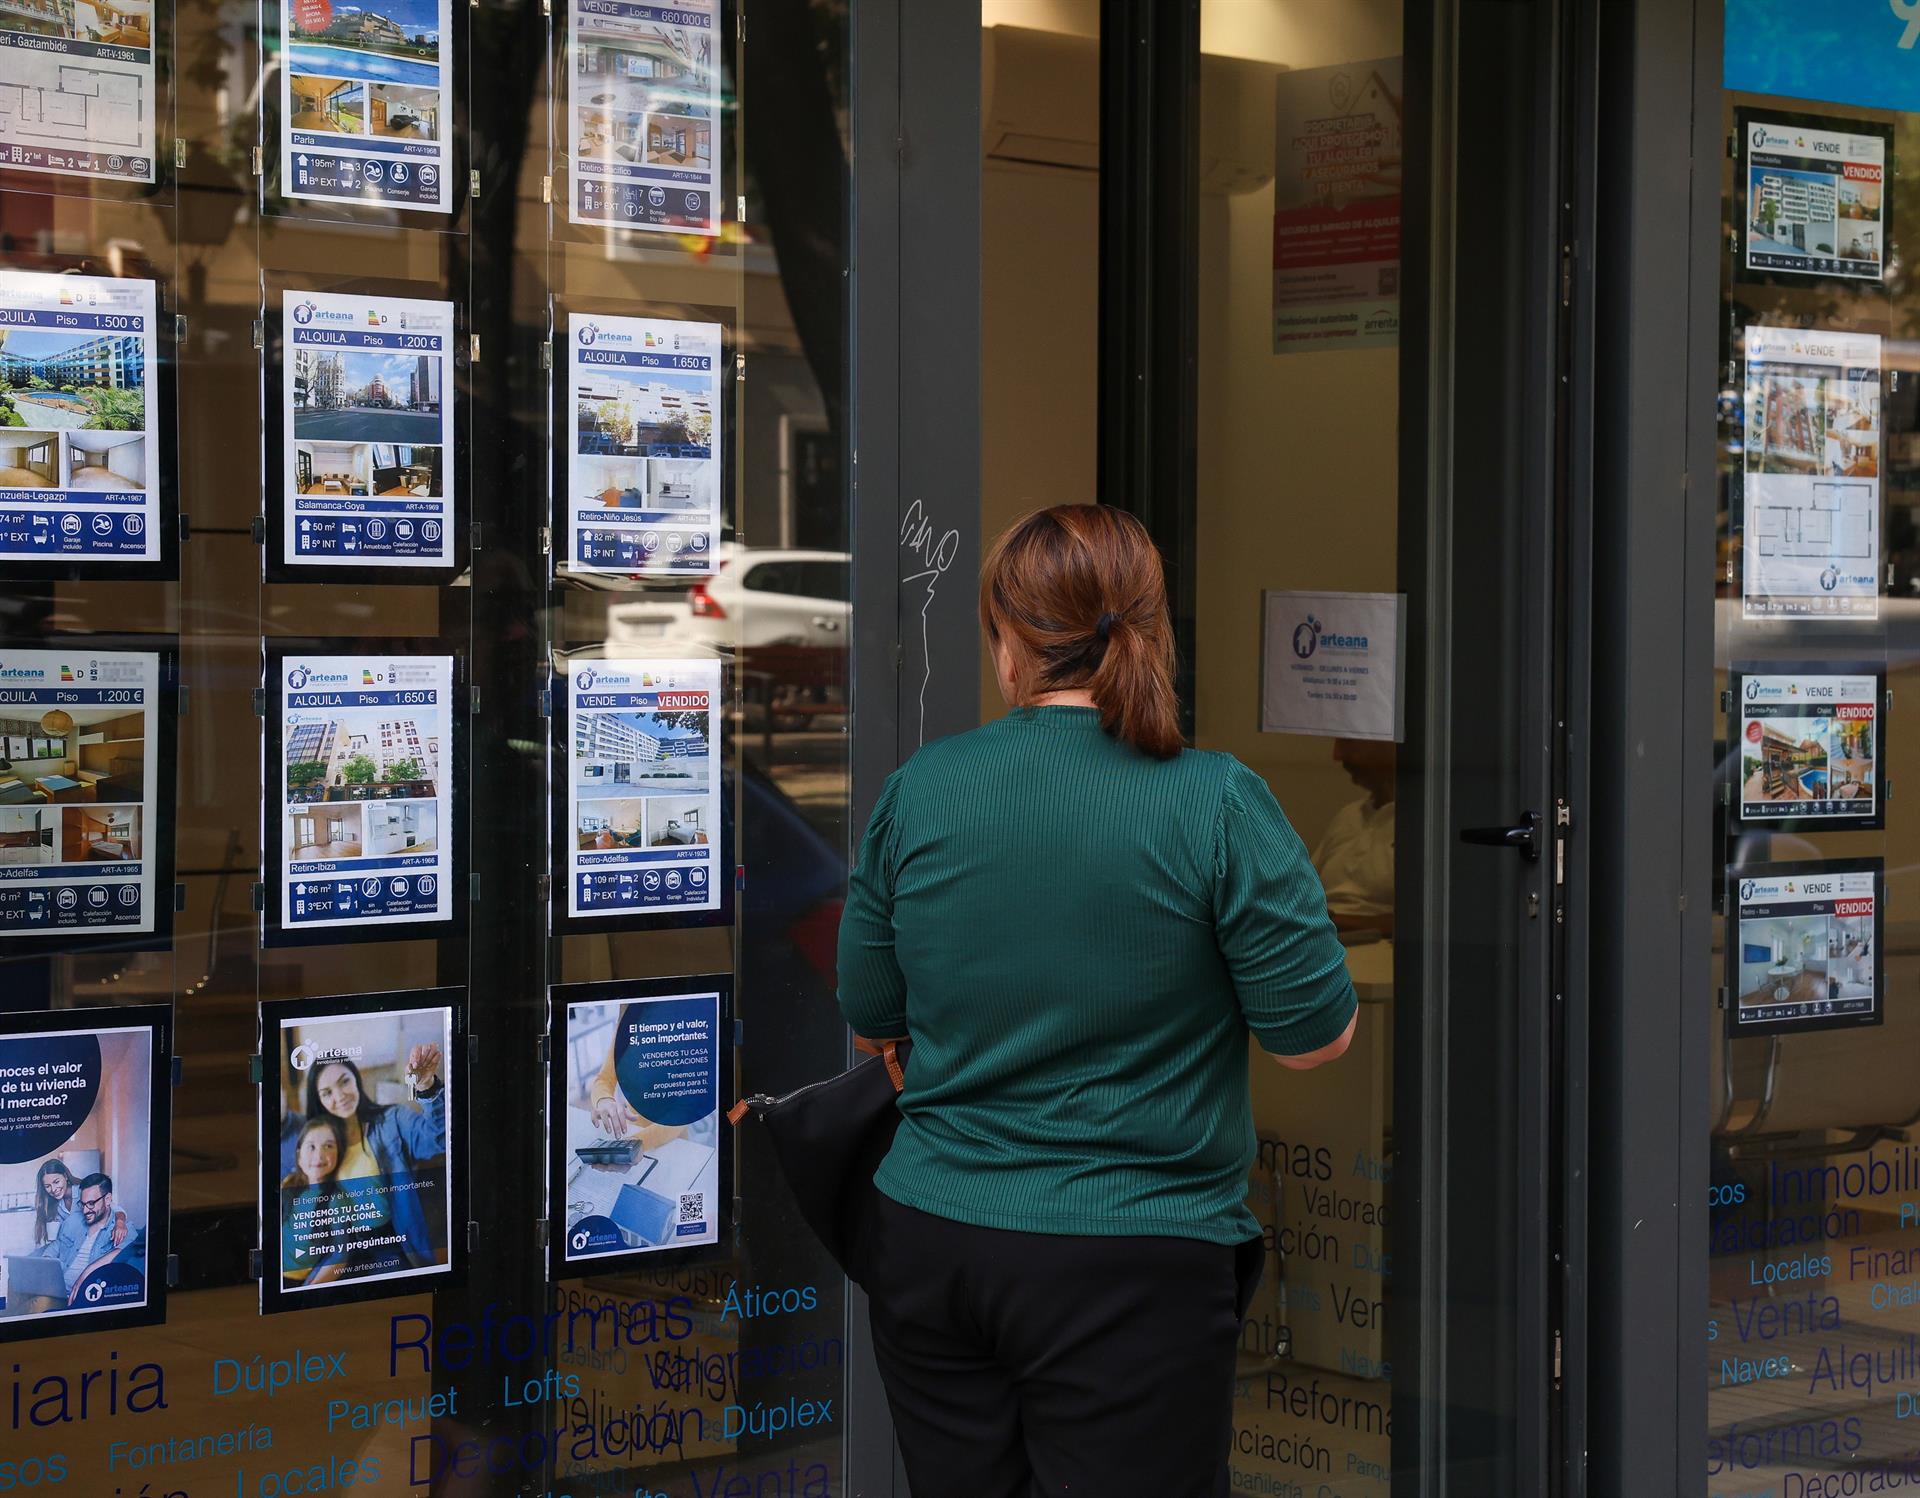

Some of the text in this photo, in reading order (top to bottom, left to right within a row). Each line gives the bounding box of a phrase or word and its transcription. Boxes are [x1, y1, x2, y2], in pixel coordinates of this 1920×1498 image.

[584, 0, 701, 26] VENDE Local 660.000
[17, 36, 136, 62] Gaztambide ART-V-1961
[294, 134, 315, 145] Parla
[1812, 141, 1840, 154] VENDE
[1843, 165, 1882, 182] VENDIDO
[321, 177, 337, 188] EXT
[420, 185, 438, 194] Garaje
[0, 310, 128, 329] QUILA Piso 1.500
[315, 311, 354, 321] arteana
[1364, 317, 1398, 330] arrenta
[299, 332, 428, 348] ALQUILA Piso 1.200
[598, 333, 633, 343] arteana
[1804, 345, 1835, 357] VENDE
[584, 352, 699, 368] ALQUILA Piso 1.650
[0, 491, 67, 503] nzuela-Legazpi
[298, 500, 365, 511] Salamanca-Goya
[580, 512, 642, 523] Retiro-Niño Jesús
[312, 523, 336, 532] 50 m²
[10, 532, 29, 542] EXT
[63, 536, 113, 548] Garaje Piscina
[594, 533, 603, 541] 82
[311, 539, 336, 549] 5º INT
[363, 543, 392, 551] Amueblado
[602, 549, 615, 557] INT
[1839, 574, 1874, 584] arteana
[1319, 633, 1368, 648] arteana
[1, 668, 45, 677] arteana
[310, 673, 348, 682] arteana
[595, 675, 630, 684] arteana
[0, 690, 131, 702] QUILA Piso 1.200
[294, 692, 424, 705] ALQUILA Piso 1.650
[1759, 687, 1833, 697] arteana VENDE
[582, 695, 709, 707] VENDE Piso VENDIDO
[1835, 707, 1874, 719] VENDIDO
[579, 854, 629, 864] Retiro-Adelfas
[291, 862, 336, 872] Retiro-Ibiza
[594, 874, 607, 883] 109
[308, 883, 332, 893] 66 m²
[1754, 883, 1832, 894] arteana VENDE
[602, 890, 617, 900] EXT
[1835, 901, 1873, 914] VENDIDO
[6, 909, 25, 920] EXT
[629, 1019, 708, 1033] El tiempo el valor,
[641, 1032, 708, 1044] son importantes.
[316, 1046, 362, 1059] arteana
[641, 1050, 679, 1060] VENDEMOS
[638, 1056, 709, 1069] SIN COMPLICACIONES
[0, 1062, 82, 1077] noces el valor
[1, 1077, 87, 1093] de tu vivienda
[653, 1081, 685, 1090] propuesta
[7, 1094, 68, 1109] mercado?
[25, 1121, 72, 1129] complicaciones
[1259, 1139, 1332, 1181] mas
[1771, 1146, 1920, 1208] Inmobili
[292, 1180, 435, 1206] El tiempo el valor son importantes.
[293, 1202, 376, 1221] VENDEMOS TU CASA
[293, 1211, 383, 1230] SIN COMPLICACIONES.
[293, 1224, 372, 1242] Tenemos una oferta.
[309, 1233, 407, 1256] Entra pregúntanos
[1262, 1221, 1339, 1264] ación
[333, 1258, 400, 1275] www.arteana.com
[1750, 1252, 1832, 1286] Locales
[720, 1280, 818, 1322] Áticos
[1731, 1291, 1841, 1343] Venta
[390, 1295, 693, 1378] Reformas
[1242, 1314, 1294, 1361] nta
[1720, 1333, 1920, 1398] Naves Alquil
[11, 1349, 347, 1430] iaria Dúplex
[504, 1368, 581, 1408] Lofts
[327, 1385, 458, 1433] Parquet
[723, 1397, 834, 1440] Dúplex
[109, 1423, 273, 1472] Fontanería
[236, 1455, 381, 1498] Locales
[690, 1456, 830, 1498] Venta
